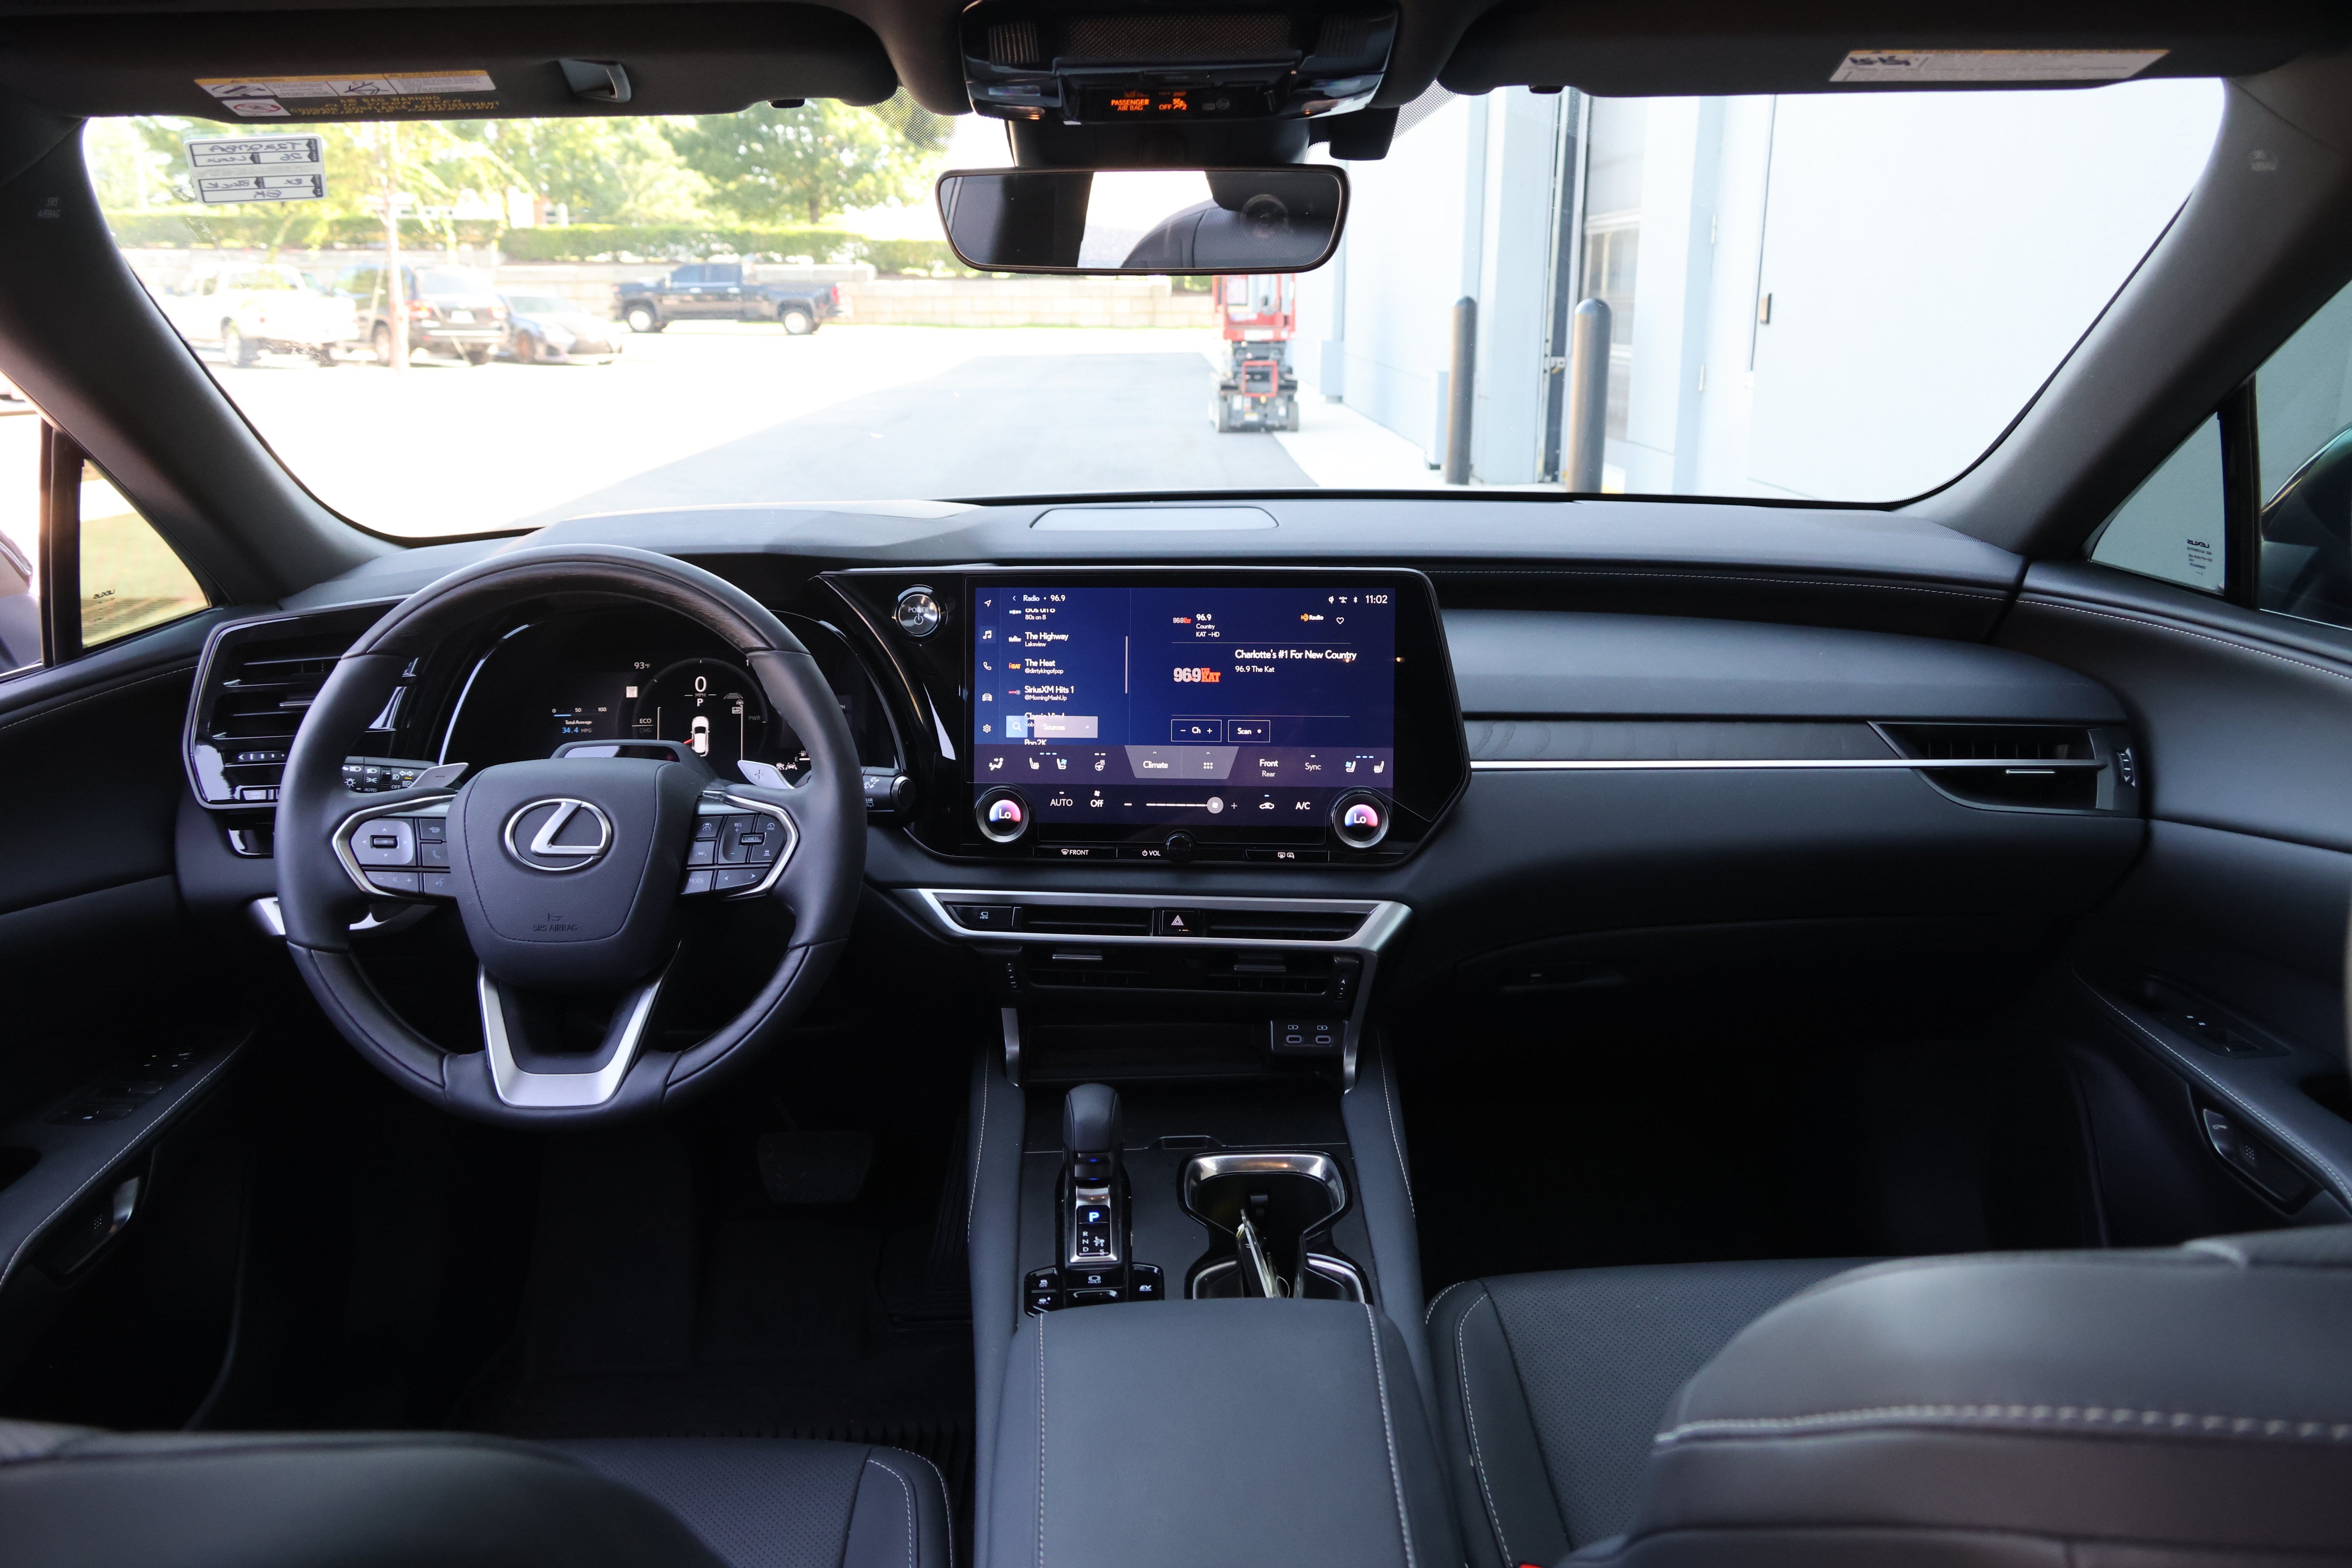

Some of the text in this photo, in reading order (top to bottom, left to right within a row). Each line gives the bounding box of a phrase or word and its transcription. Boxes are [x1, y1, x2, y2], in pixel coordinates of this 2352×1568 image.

[1365, 595, 1388, 604] 11:02
[1025, 632, 1069, 641] The Highway
[1235, 649, 1357, 661] Charlotte's #1 For New Country
[1201, 672, 1221, 682] KAT
[695, 676, 706, 692] 0
[697, 698, 704, 706] P
[1143, 761, 1169, 769] Climate
[1259, 759, 1278, 767] Front
[1305, 763, 1321, 771] Sync
[1050, 799, 1073, 807] AUTO
[1091, 800, 1104, 808] Off
[1296, 802, 1310, 810] A/C
[999, 808, 1011, 820] Lo
[1354, 813, 1367, 824] Lo
[1089, 1212, 1099, 1222] P
